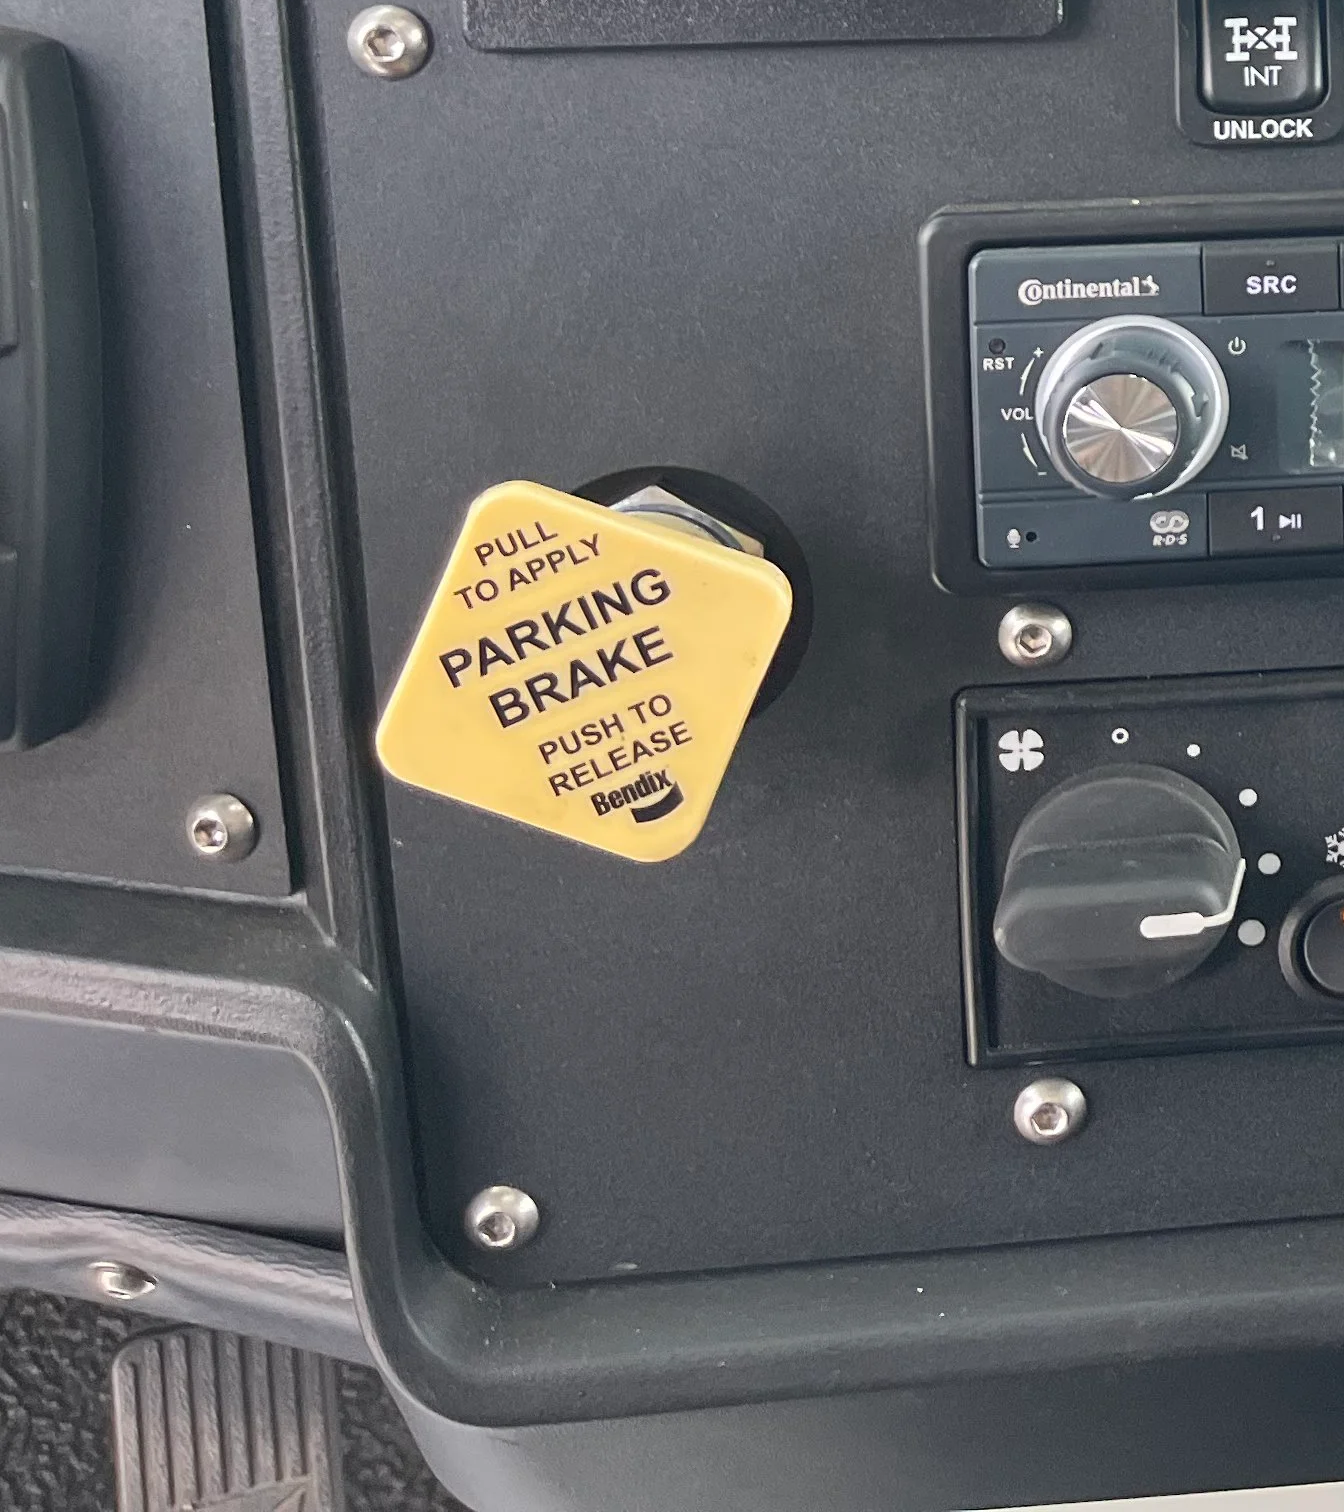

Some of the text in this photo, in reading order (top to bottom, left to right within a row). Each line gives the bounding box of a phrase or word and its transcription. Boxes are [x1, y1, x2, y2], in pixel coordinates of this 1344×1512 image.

[1243, 64, 1283, 87] INT
[1213, 117, 1315, 141] UNLOCK
[1017, 276, 1142, 306] Continental
[1245, 274, 1298, 295] SRC
[982, 356, 1015, 372] RST
[1000, 407, 1034, 422] VOL
[1249, 505, 1265, 531] 1
[473, 521, 559, 567] PULL
[452, 532, 602, 610] TO APPLY
[438, 568, 672, 688] PARKING
[487, 625, 675, 728] BRAKE
[537, 693, 673, 765] PUSH TO
[547, 720, 694, 797] RELEASE
[589, 767, 672, 818] Bendix
